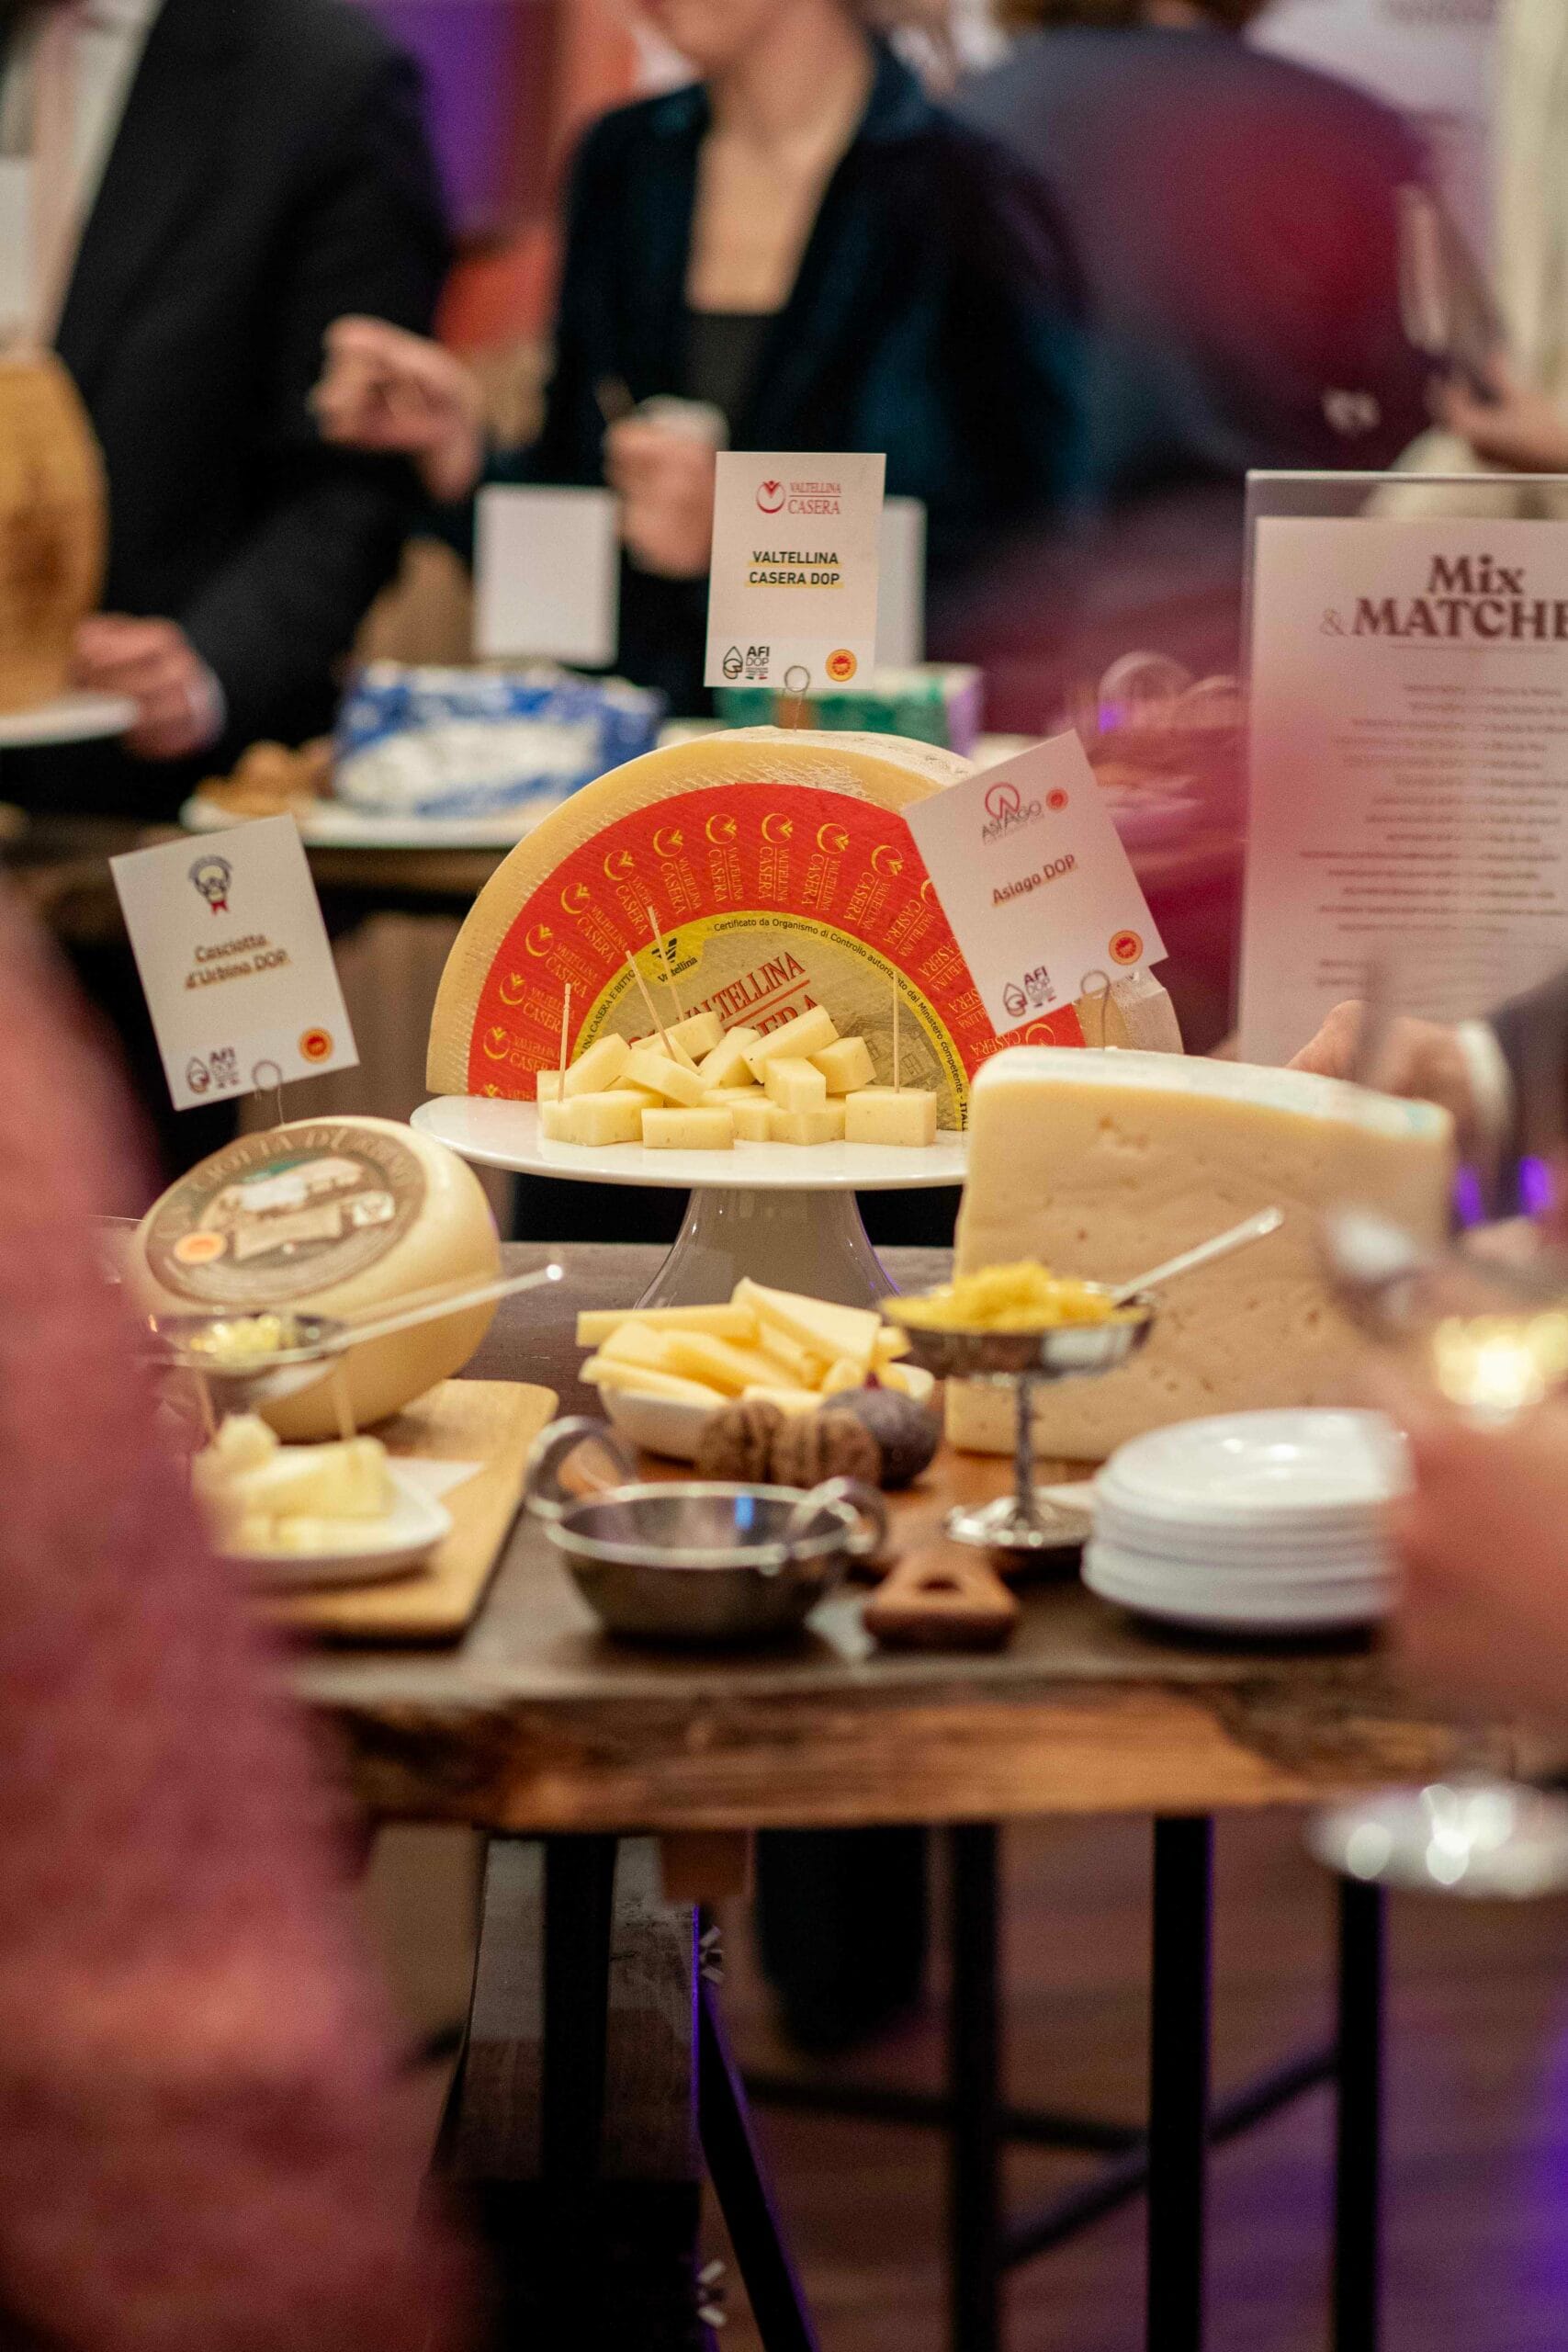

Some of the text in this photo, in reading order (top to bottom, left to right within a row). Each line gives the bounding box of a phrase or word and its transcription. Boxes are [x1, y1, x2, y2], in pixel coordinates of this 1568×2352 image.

[788, 499, 841, 514] CASERA
[749, 571, 840, 585] CASERA DOP
[752, 551, 840, 565] VALTELLINA
[1427, 553, 1524, 595] Mix
[746, 657, 770, 667] DOP
[747, 646, 770, 657] AFI
[982, 800, 1043, 838] ASIAGO
[660, 862, 687, 915] CASERA
[679, 856, 703, 910] VALTELLINA
[709, 849, 728, 902] CASERA
[728, 847, 743, 900] VALTELLINA
[759, 846, 773, 899] CASERA
[778, 848, 789, 902] VALTELLINA
[801, 854, 825, 906] CASERA
[821, 860, 841, 911] VALTELLINA
[992, 854, 1075, 904] Asiago DOP
[615, 885, 649, 935] CASERA
[844, 871, 875, 922] CASERA
[862, 882, 891, 931] VALTELLINA
[577, 917, 616, 964] CASERA
[882, 899, 921, 945] CASERA
[898, 912, 936, 957] VALTELLINA
[545, 956, 589, 999] CASERA
[657, 956, 698, 983] Vtellina
[1023, 965, 1048, 986] AFI
[523, 1003, 562, 1033] CASER
[590, 968, 637, 1032] CASERA E BITTO
[714, 919, 756, 932] Certificato
[759, 918, 770, 926] da
[772, 918, 818, 935] Organismo
[820, 928, 829, 939] di
[830, 933, 867, 957] Controllo
[907, 989, 919, 1003] dal
[918, 1002, 943, 1040] Ministero
[941, 1041, 963, 1093] competente
[948, 988, 984, 1013] SERA
